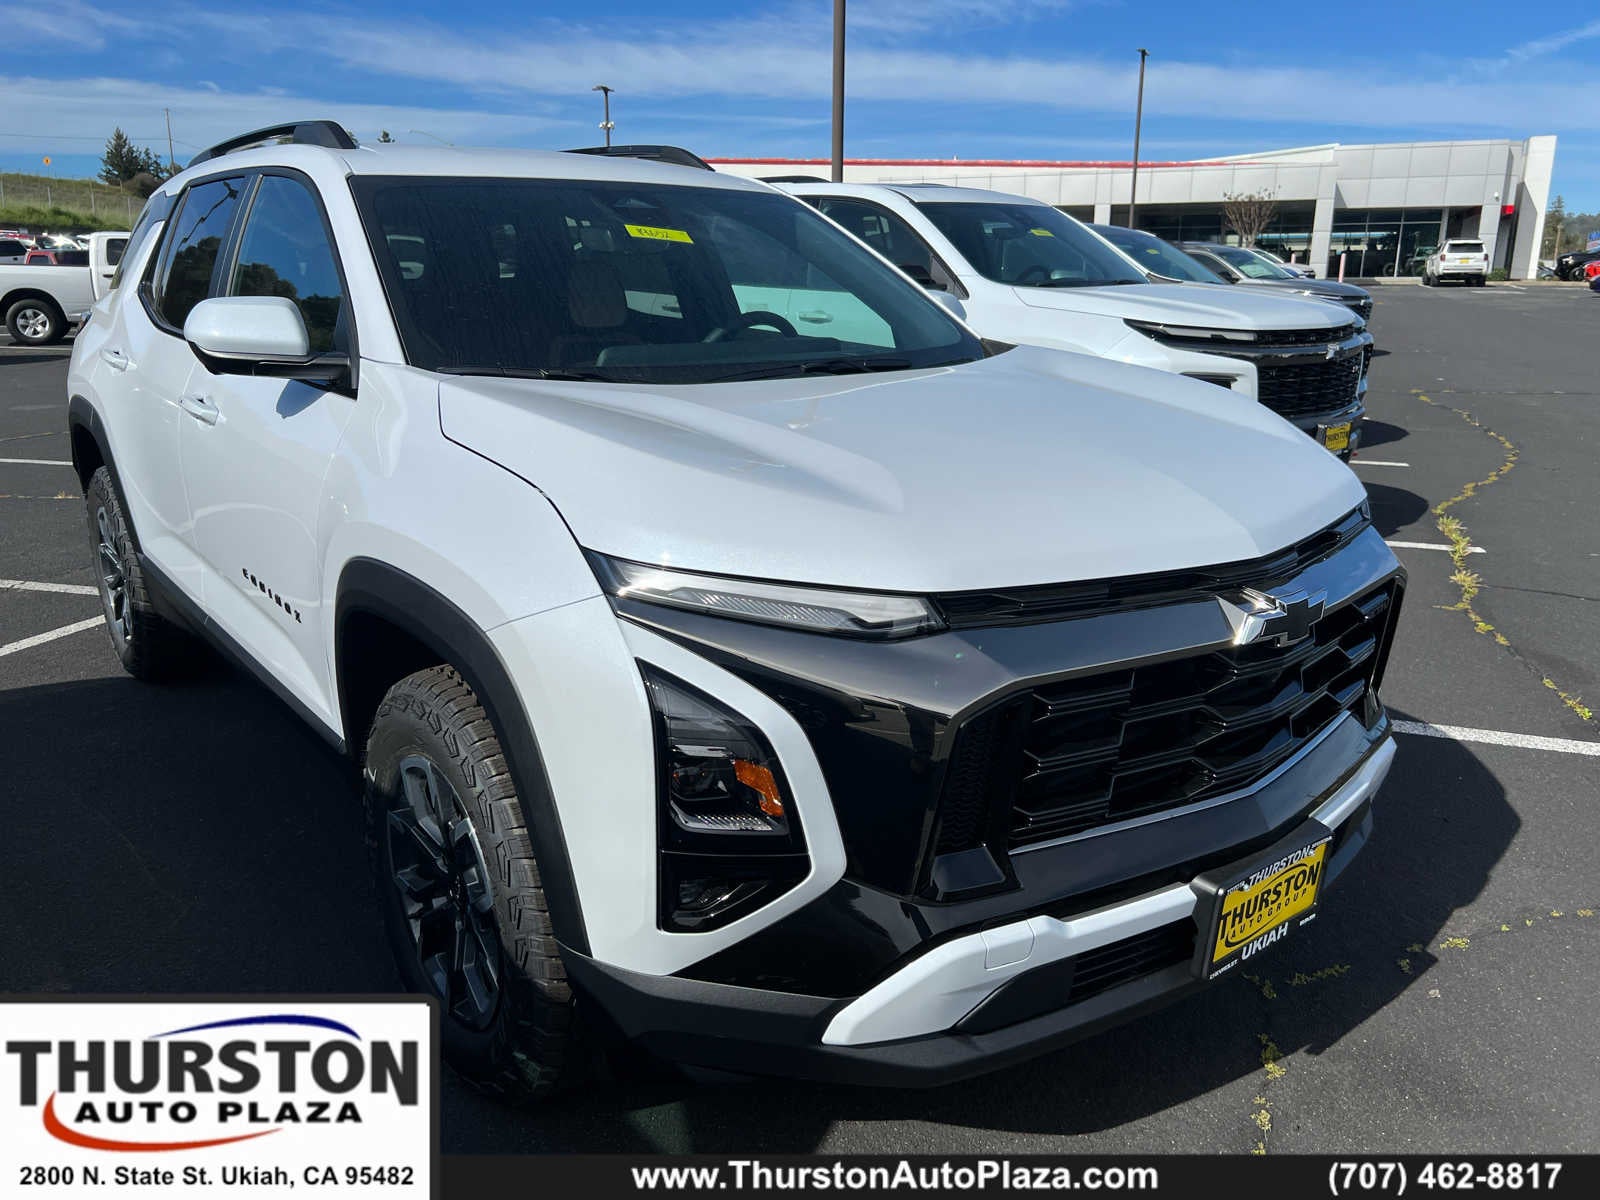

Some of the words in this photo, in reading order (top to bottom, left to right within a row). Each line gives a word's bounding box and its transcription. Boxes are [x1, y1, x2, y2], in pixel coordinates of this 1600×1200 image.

[242, 568, 302, 624] EQUINOX
[1249, 844, 1312, 885] THURSTON
[1219, 861, 1320, 941] THURSTON
[1231, 914, 1263, 938] AUTO
[1267, 888, 1308, 917] GROUP
[1241, 922, 1289, 961] UKIAH
